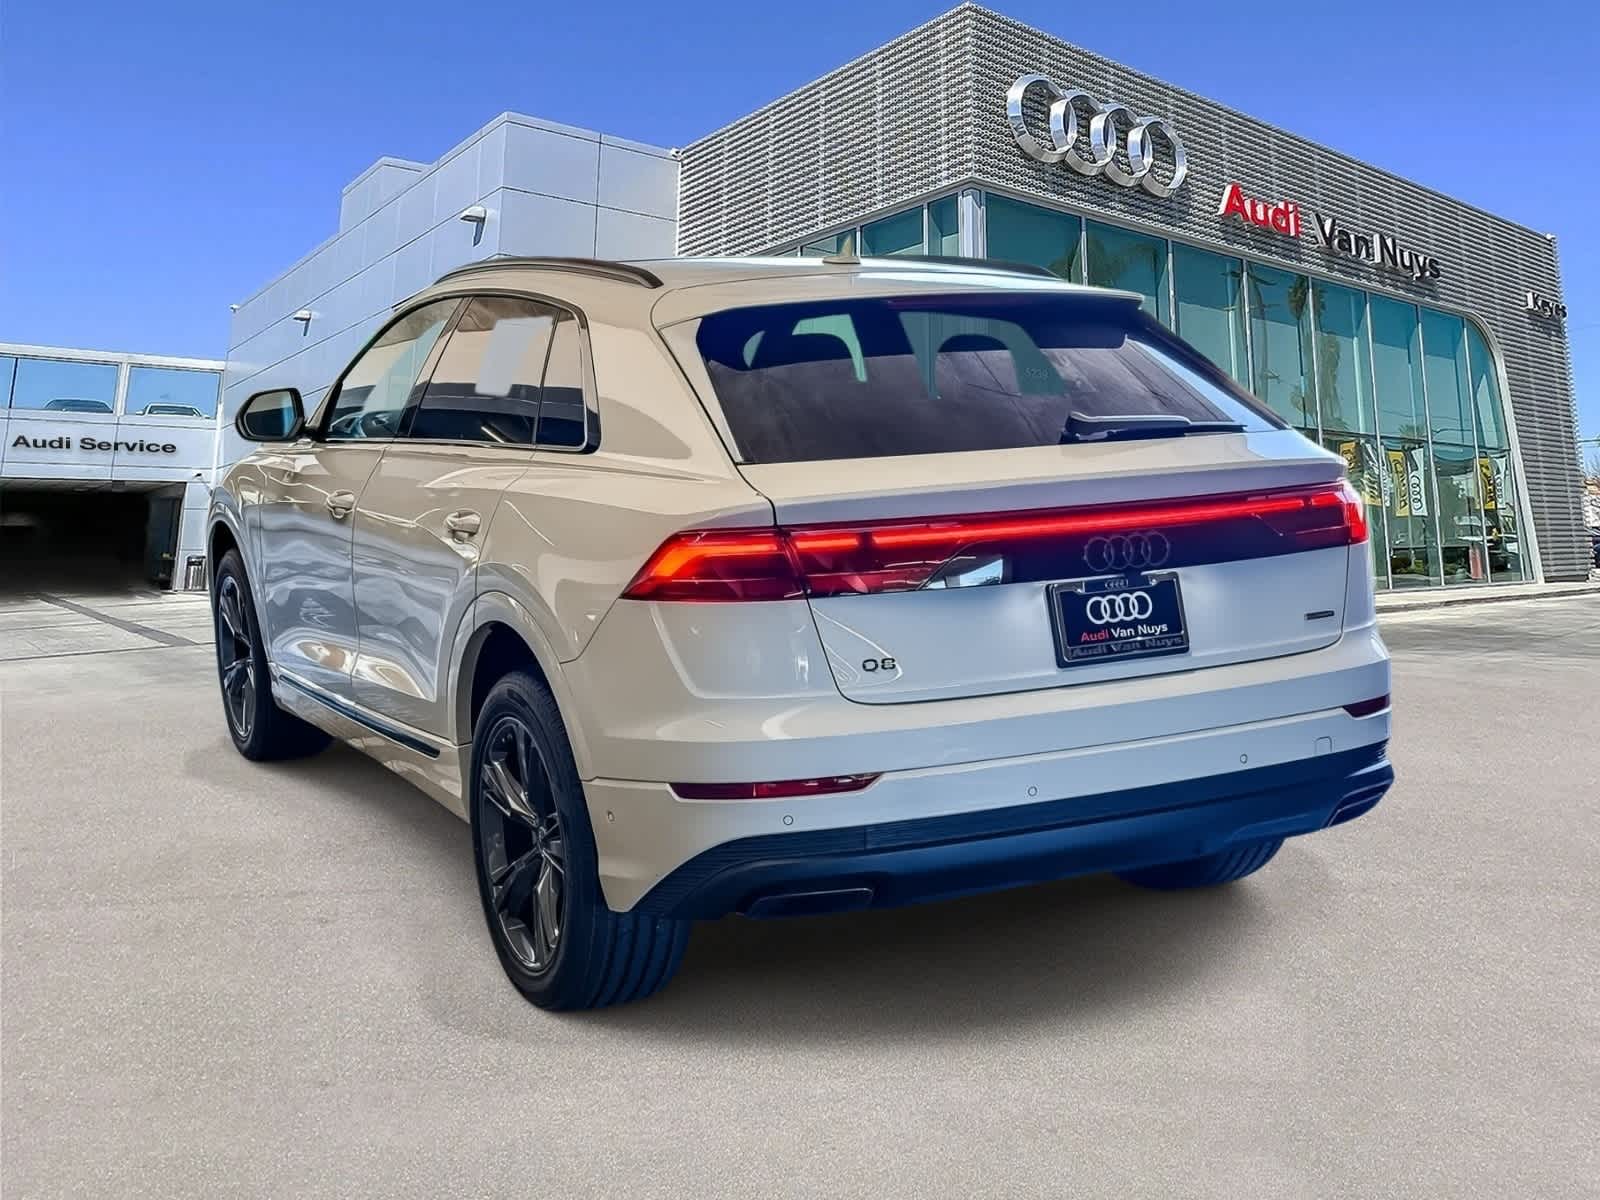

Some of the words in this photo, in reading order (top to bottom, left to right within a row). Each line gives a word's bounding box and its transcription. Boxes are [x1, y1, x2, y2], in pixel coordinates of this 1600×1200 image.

[1218, 183, 1302, 238] Audi
[1312, 211, 1370, 258] Van
[1373, 233, 1441, 280] Nuys
[12, 435, 71, 449] Audi
[80, 437, 177, 453] Service
[1081, 629, 1109, 642] Audi
[1110, 626, 1135, 638] Van
[1137, 623, 1169, 636] Nuys
[1071, 644, 1107, 656] Audi
[1110, 641, 1142, 652] Van
